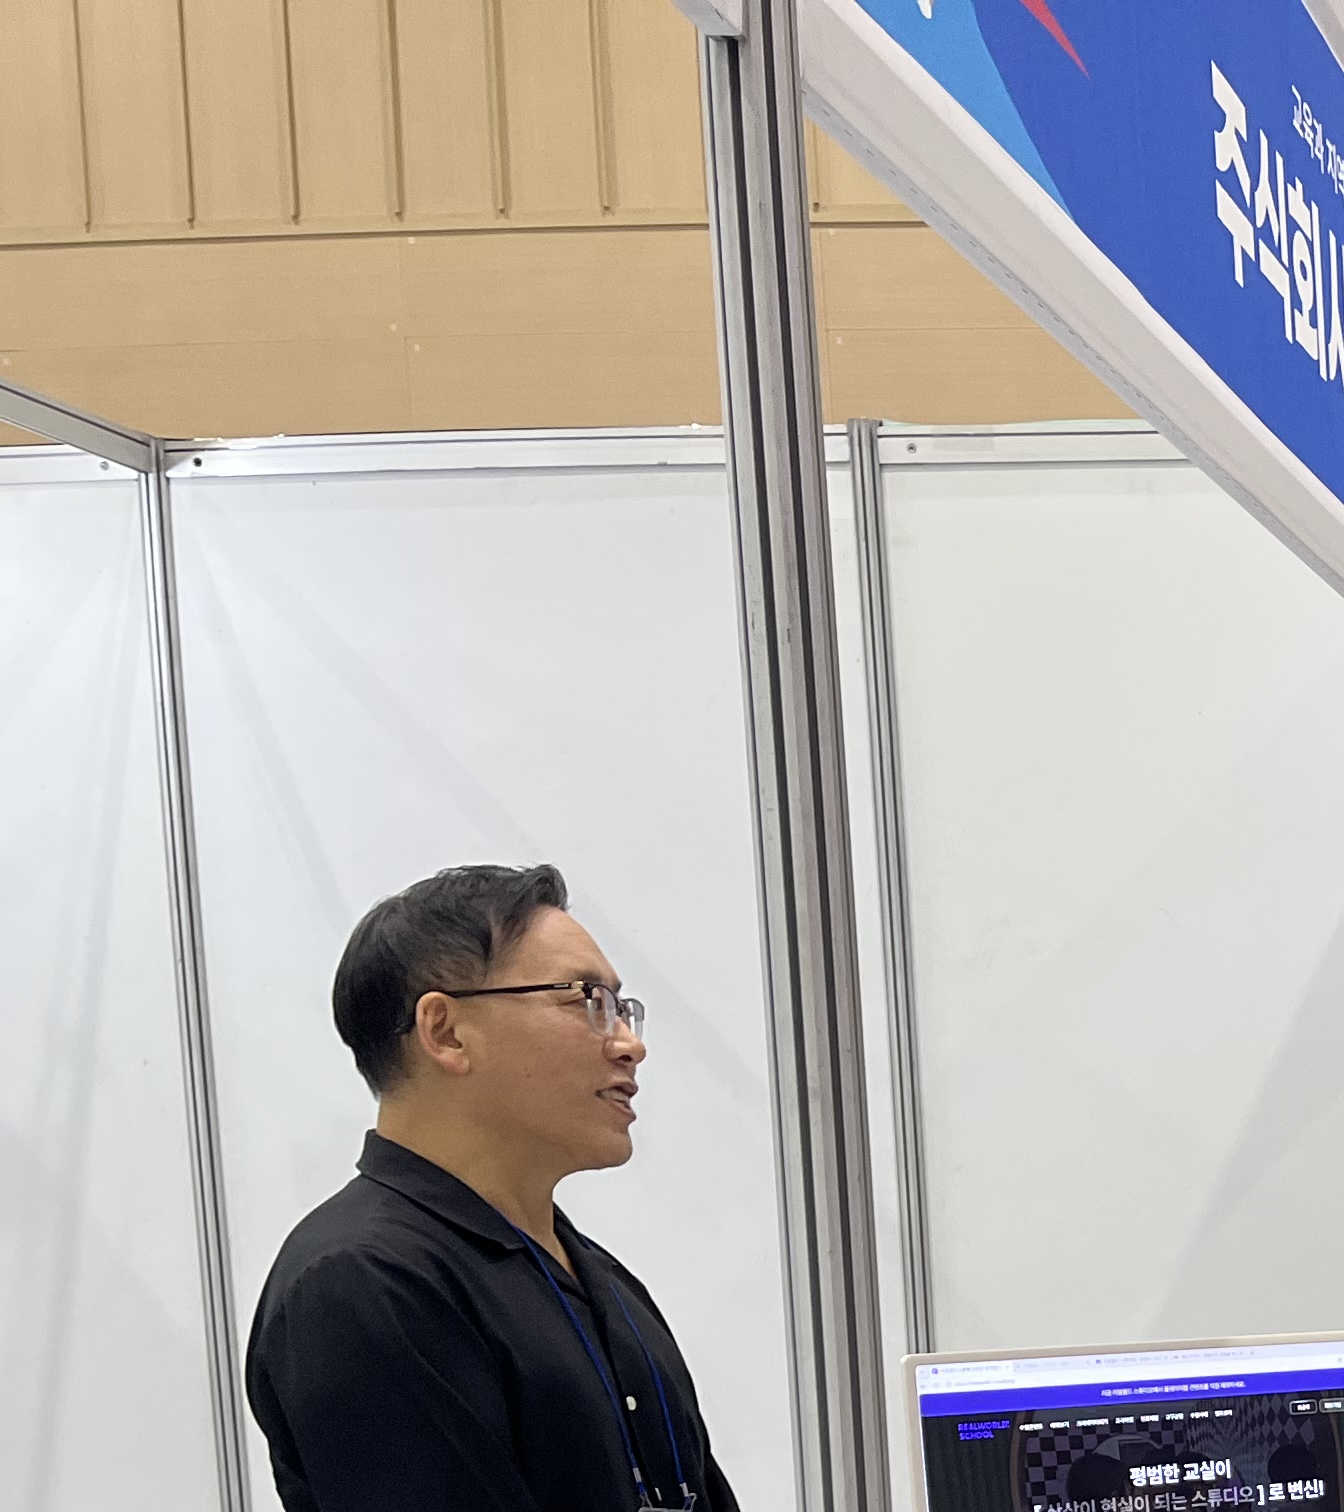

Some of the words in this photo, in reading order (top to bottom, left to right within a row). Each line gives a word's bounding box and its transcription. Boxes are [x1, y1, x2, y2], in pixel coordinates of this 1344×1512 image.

[1292, 85, 1324, 174] 교육과
[1129, 1464, 1180, 1487] 평범한
[1183, 1459, 1232, 1483] 교실이
[1155, 1491, 1187, 1512] 되는
[1191, 1486, 1255, 1509] 스튜디오
[1268, 1482, 1285, 1502] 로
[1287, 1478, 1325, 1499] 변신!
